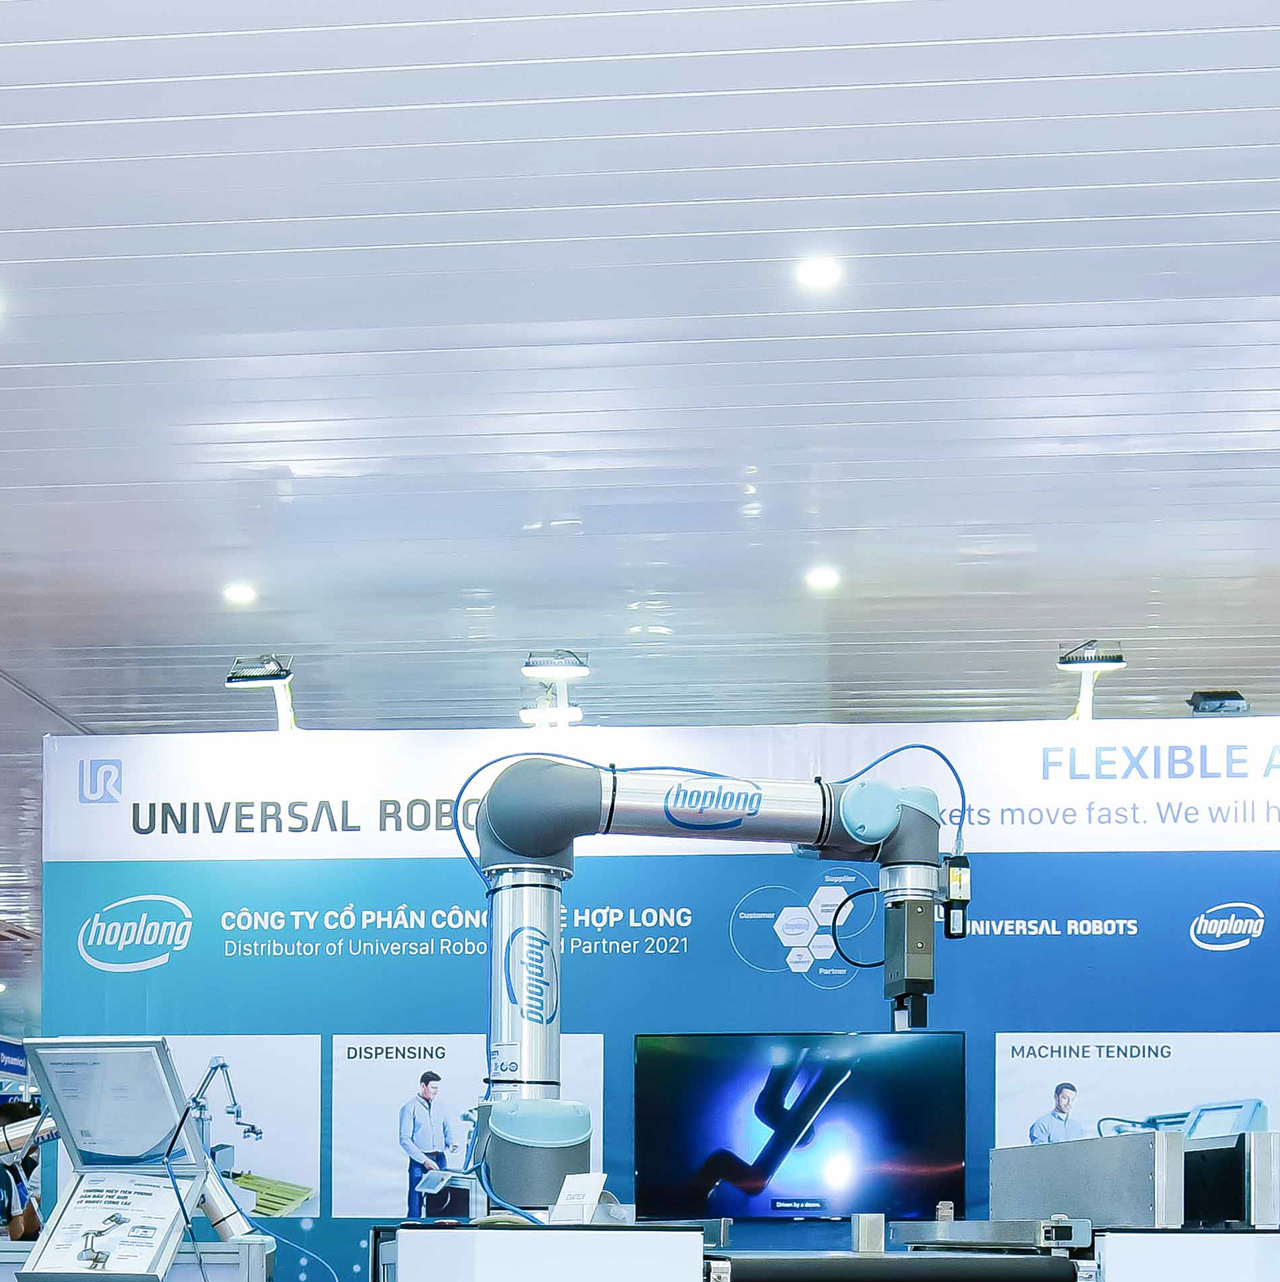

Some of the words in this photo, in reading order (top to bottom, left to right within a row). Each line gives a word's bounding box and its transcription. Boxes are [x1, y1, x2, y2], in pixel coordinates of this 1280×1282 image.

[1042, 745, 1248, 780] FLEXIBLE
[132, 800, 361, 834] UNIVERSAL
[1000, 807, 1078, 826] move
[1087, 802, 1148, 826] fast.
[1156, 801, 1199, 823] We
[1208, 800, 1255, 823] will
[220, 907, 285, 930] CÔNG
[290, 911, 318, 930] TY
[323, 903, 356, 930] CỔ
[361, 903, 425, 930] PHẦN
[574, 906, 623, 932] HỢP
[629, 906, 693, 928] LONG
[1067, 919, 1138, 936] ROBOTS
[224, 939, 321, 957] Distributor
[326, 938, 343, 956] of
[349, 938, 433, 956] Universal
[440, 938, 488, 955] Robo
[570, 936, 638, 955] Partner
[645, 936, 688, 954] 2021
[347, 1046, 446, 1059] DISPENSING
[1011, 1045, 1090, 1058] MACHINE
[1095, 1045, 1172, 1058] TENDING
